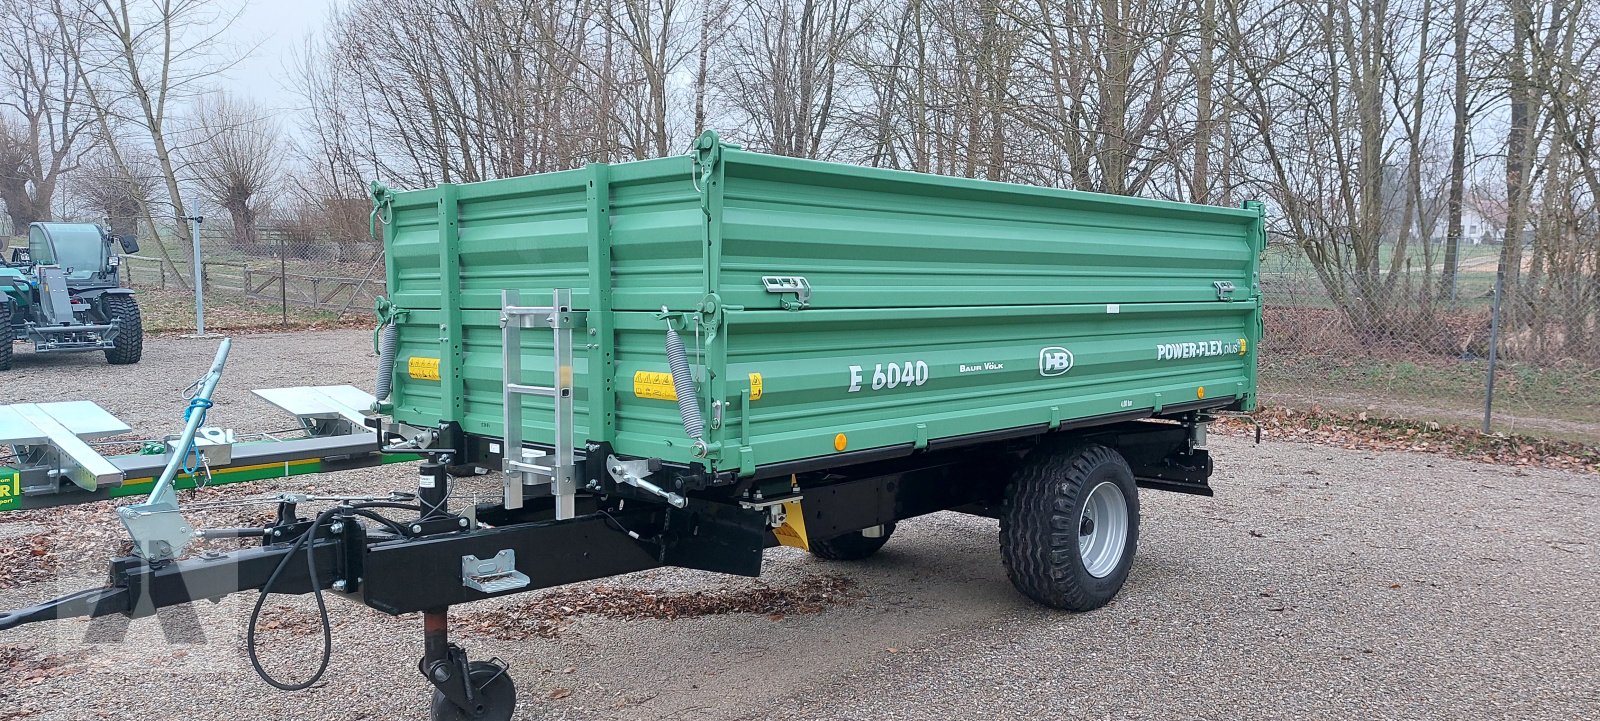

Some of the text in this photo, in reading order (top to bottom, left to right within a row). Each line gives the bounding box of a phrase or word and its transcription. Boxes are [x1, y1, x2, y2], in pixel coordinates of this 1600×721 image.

[1156, 340, 1222, 361] POWER-FLEX
[1044, 352, 1069, 371] HB
[848, 360, 929, 393] E 6040
